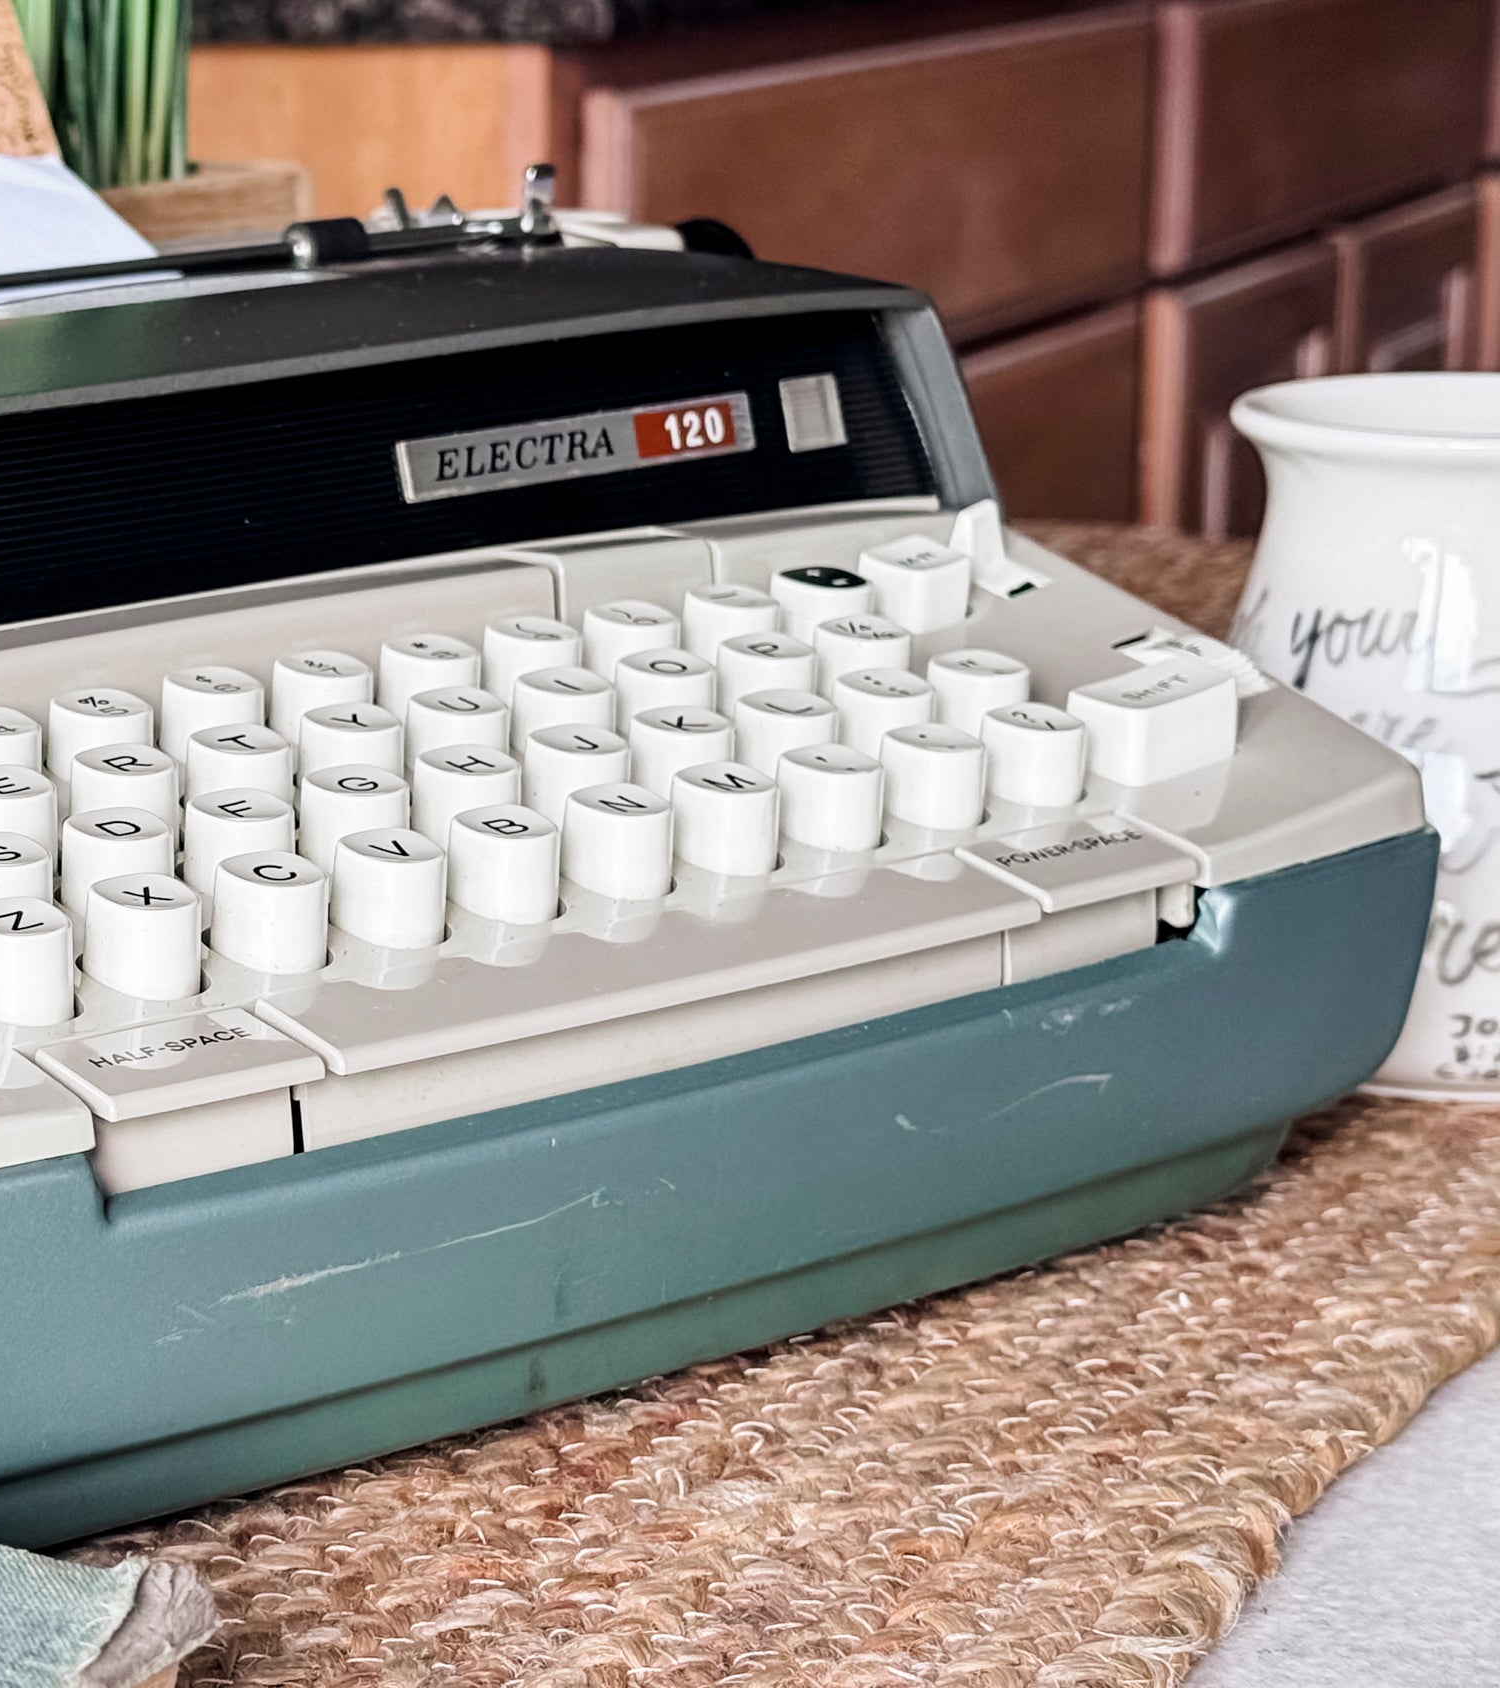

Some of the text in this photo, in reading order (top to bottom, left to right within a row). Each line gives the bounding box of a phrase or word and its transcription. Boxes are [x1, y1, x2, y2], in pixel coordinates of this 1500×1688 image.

[436, 406, 728, 482] ELECTRA 120
[746, 641, 779, 657] P
[649, 660, 688, 674] O
[1121, 672, 1190, 701] SHIFT
[438, 697, 481, 711] U
[764, 702, 814, 716] L
[330, 711, 370, 728] Y
[659, 714, 709, 732] K
[217, 734, 257, 751] T
[571, 734, 600, 750] J
[102, 754, 155, 772] R
[445, 754, 496, 774] H
[337, 775, 379, 792] G
[701, 772, 759, 792] M
[217, 799, 254, 817] F
[598, 794, 650, 813] N
[94, 819, 142, 836] D
[481, 818, 530, 835] B
[368, 839, 411, 859] V
[995, 829, 1143, 868] POWER-SPACE
[251, 864, 298, 883] C
[121, 885, 175, 906] X
[88, 1026, 252, 1069] HALF-SPACE
